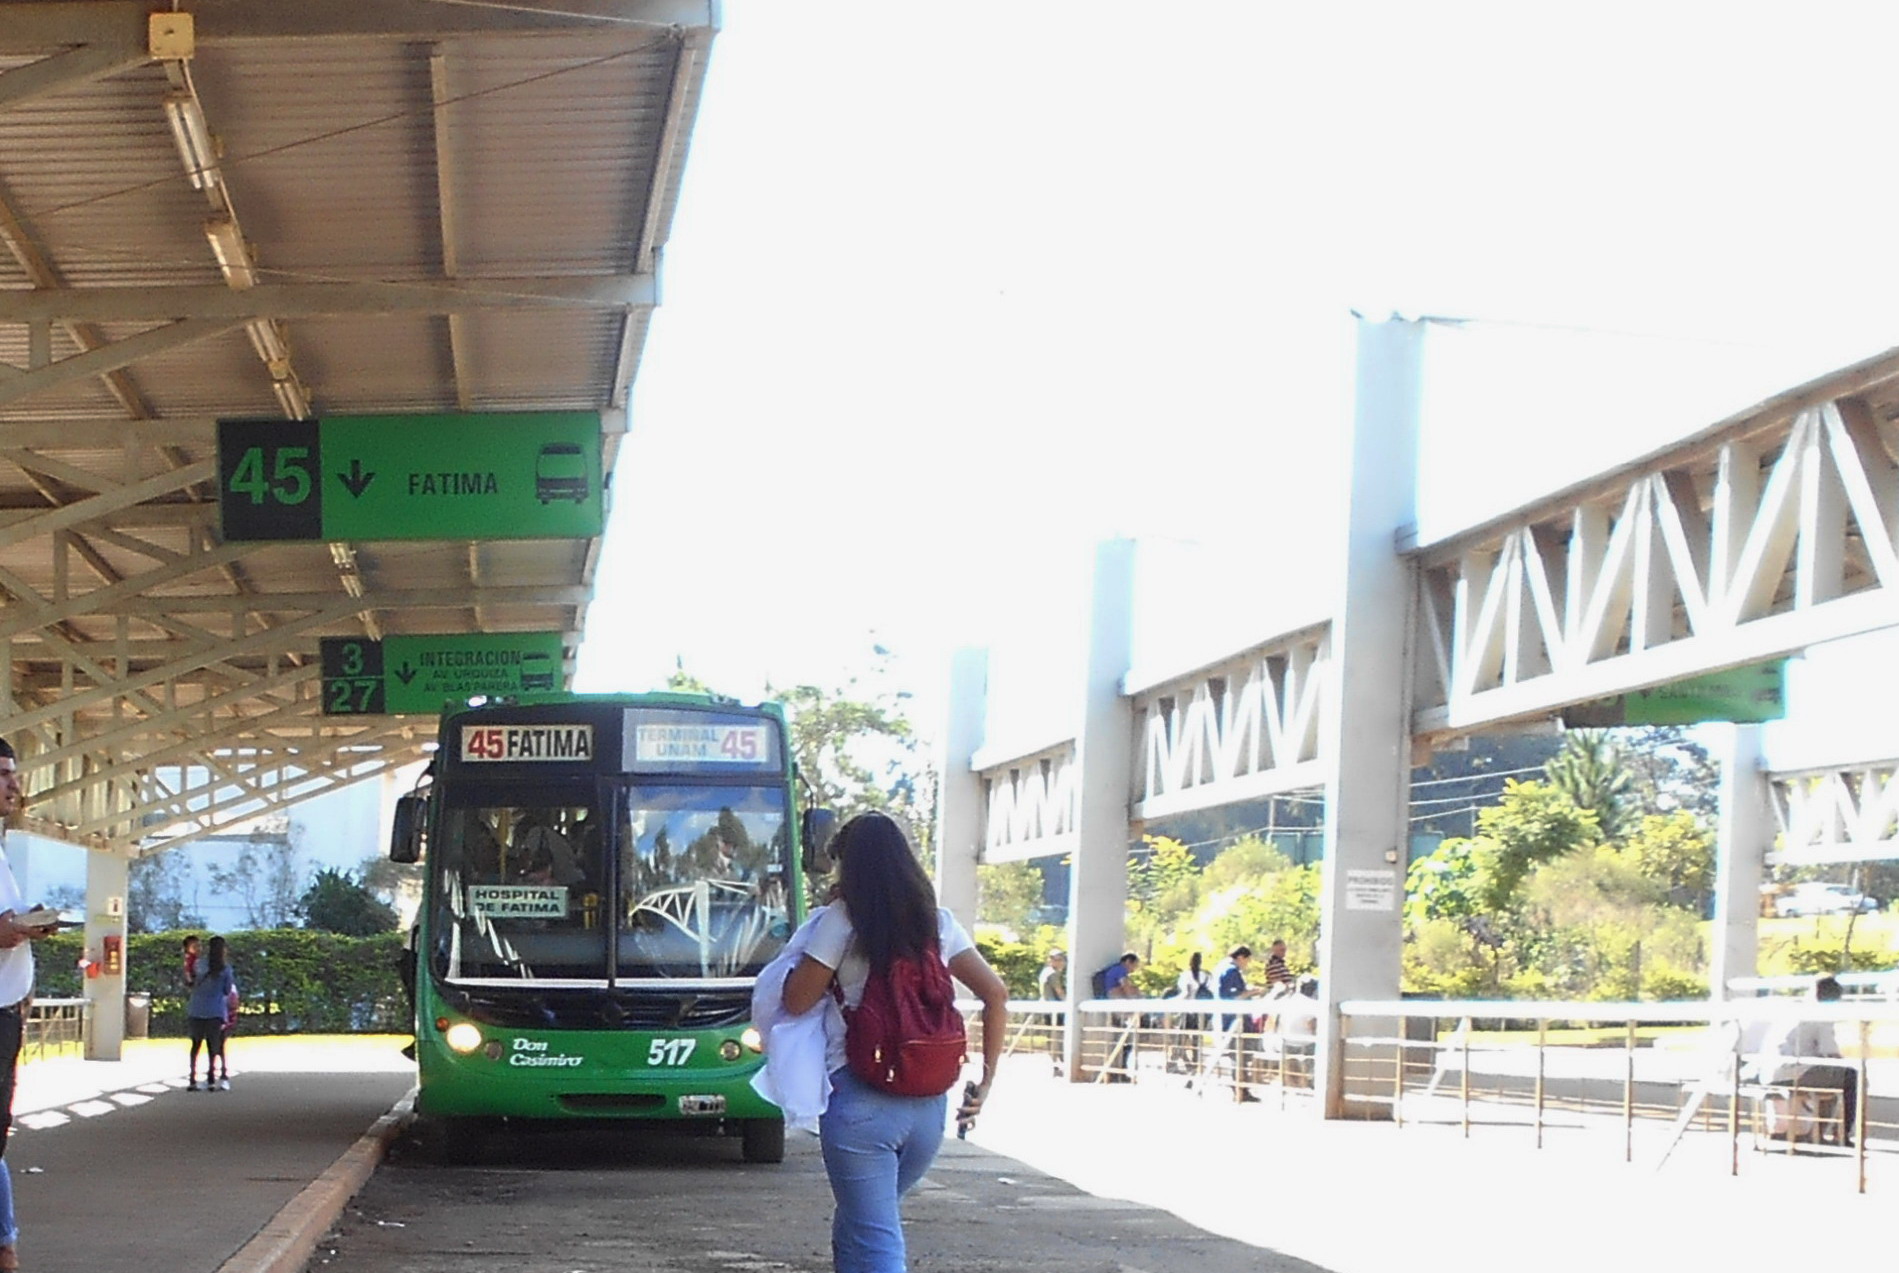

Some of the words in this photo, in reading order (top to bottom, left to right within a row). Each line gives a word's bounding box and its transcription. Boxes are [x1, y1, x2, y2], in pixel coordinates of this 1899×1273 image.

[229, 447, 311, 505] 45
[408, 472, 498, 496] FATIMA
[342, 643, 363, 675] 3
[420, 650, 521, 667] INTEGRACION
[330, 681, 378, 711] 27
[467, 730, 504, 759] 45
[507, 730, 590, 758] FATIMA
[639, 728, 719, 742] TERMINAL
[720, 730, 757, 760] 45
[475, 890, 559, 900] HOSPITAL
[475, 902, 496, 912] DE
[501, 903, 560, 913] FATIMA
[513, 1038, 548, 1051] Don
[647, 1039, 696, 1066] 517
[509, 1053, 583, 1067] Casimiro
